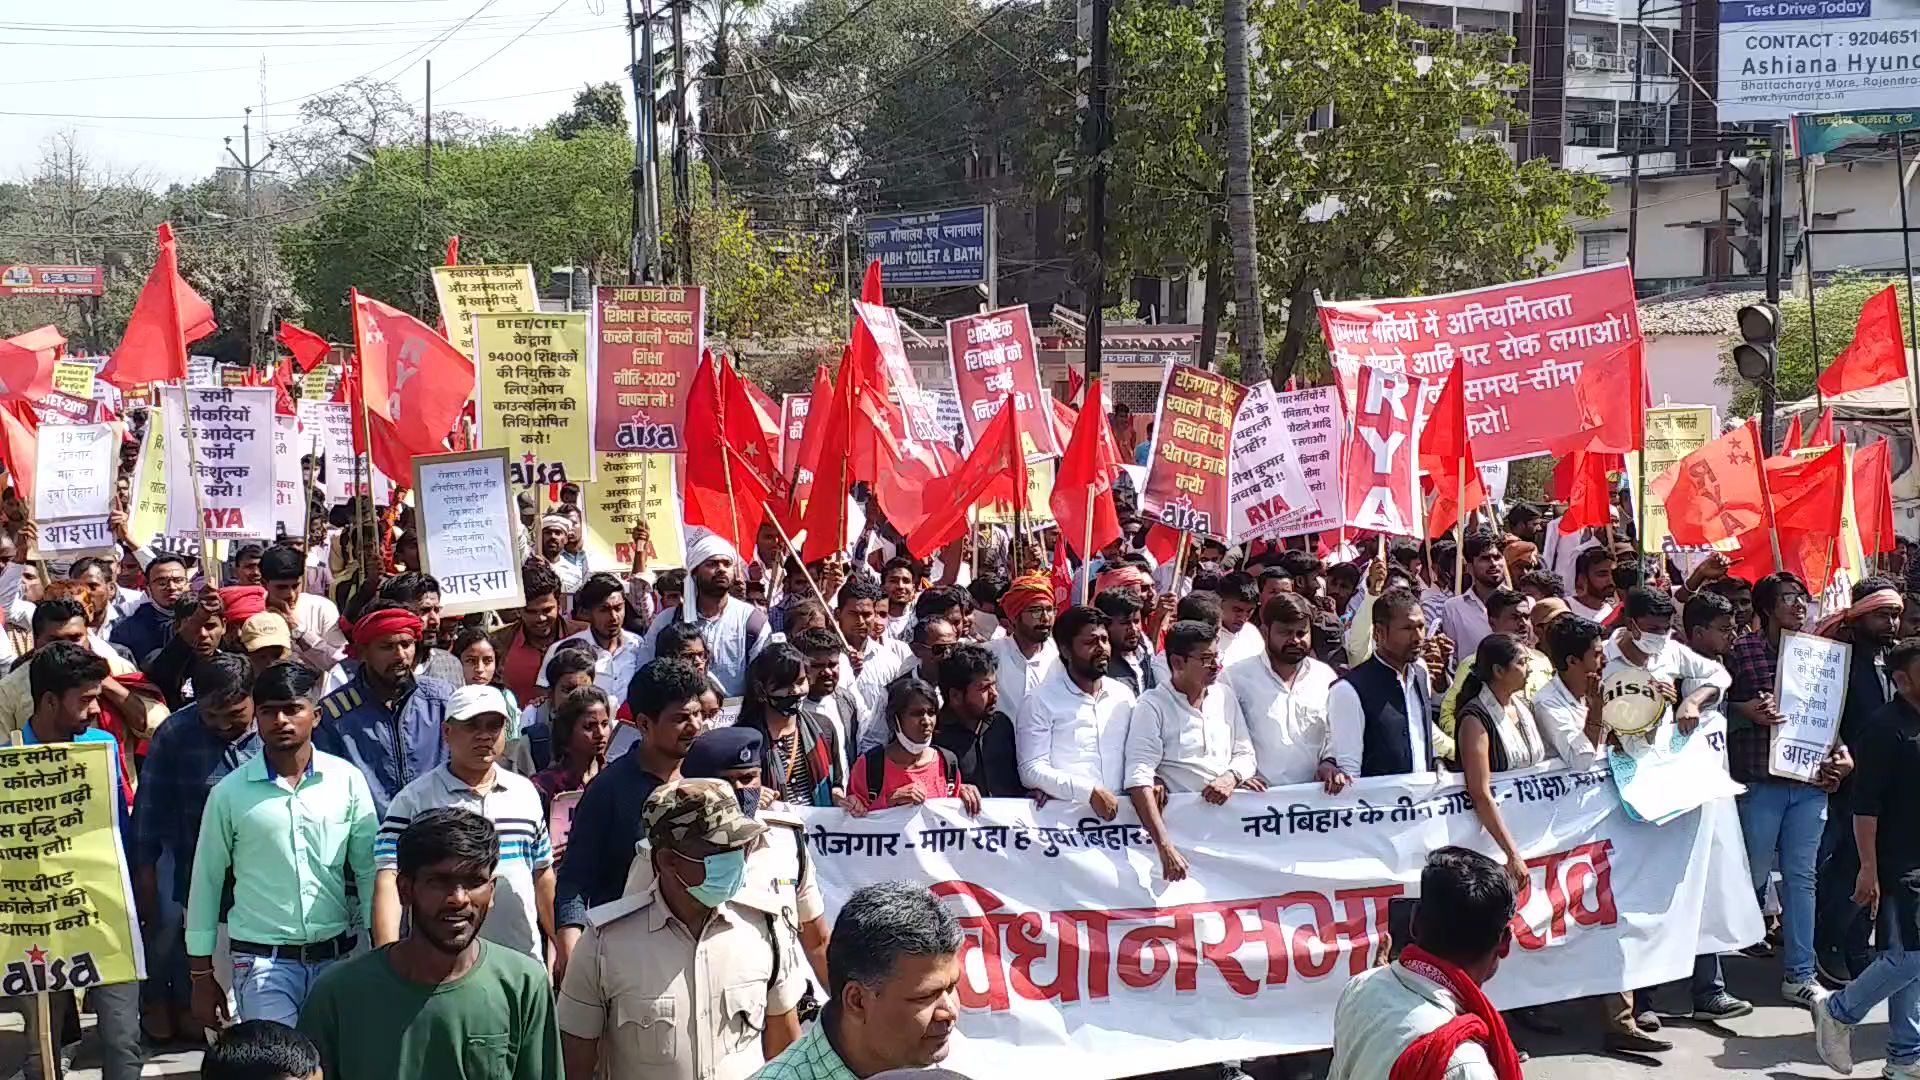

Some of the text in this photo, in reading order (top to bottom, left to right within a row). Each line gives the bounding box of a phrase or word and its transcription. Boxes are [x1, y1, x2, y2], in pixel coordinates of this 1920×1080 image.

[1744, 1, 1865, 17] Test Drive Today
[1745, 33, 1833, 50] CONTACT
[1848, 29, 1917, 46] 9204651
[1741, 56, 1837, 75] Ashiana
[1741, 79, 1821, 91] Bhattacharya
[905, 249, 940, 264] TOILET
[943, 248, 951, 263] &
[954, 246, 983, 262] BATH
[448, 280, 523, 293] और अस्पतालों
[612, 286, 686, 303] आम छात्रों को
[457, 298, 467, 307] में
[469, 294, 499, 308] खाली
[603, 305, 693, 324] शिक्षा से बेदखल
[1422, 309, 1440, 338] में
[1447, 294, 1572, 336] अनियमितता
[513, 333, 552, 348] के द्वारा
[602, 327, 633, 344] करने
[636, 326, 662, 344] वाली
[488, 349, 578, 363] 94000 शिक्षकों
[632, 348, 663, 365] शिक्षा
[1460, 343, 1491, 366] पर
[1496, 331, 1541, 361] रोक
[496, 365, 571, 382] की नियुक्ति के
[199, 388, 234, 403] सभी
[504, 382, 564, 396] लिए ओपन
[1294, 389, 1319, 402] भर्तियों
[559, 397, 576, 411] की
[617, 392, 649, 407] वापस
[1166, 393, 1203, 419] खाली
[1254, 402, 1269, 414] के
[1313, 403, 1330, 414] पेपर
[502, 414, 568, 428] तिथि घोषित
[1235, 415, 1272, 440] बहाली
[1312, 416, 1332, 430] आदि
[202, 424, 255, 442] आवेदन
[616, 423, 678, 449] aisa
[1172, 418, 1210, 446] स्थिति
[200, 442, 236, 460] फॉर्म
[1161, 440, 1182, 464] श्वेत
[1184, 449, 1203, 469] पत्र
[1353, 367, 1410, 529] RYA
[1253, 452, 1286, 479] कुमार
[1160, 500, 1211, 534] aisa
[1244, 493, 1292, 527] RYA
[45, 522, 108, 544] आइसा
[440, 569, 510, 596] आइसा
[23, 746, 68, 764] समेत
[3, 763, 88, 789] कॉलेजों में
[19, 815, 58, 842] वृद्धि
[60, 808, 84, 828] को
[1241, 805, 1284, 837] नये
[1286, 803, 1354, 834] बिहार
[1357, 799, 1385, 826] के
[1391, 796, 1433, 823] तीन
[919, 819, 968, 853] मांग
[970, 824, 1010, 853] रहा
[1013, 816, 1031, 851] है
[1036, 826, 1078, 858] युवा
[2, 870, 74, 893] नए बीएड
[60, 888, 87, 907] की
[930, 879, 1404, 1011] विधानसभा
[2, 951, 101, 996] aisa
